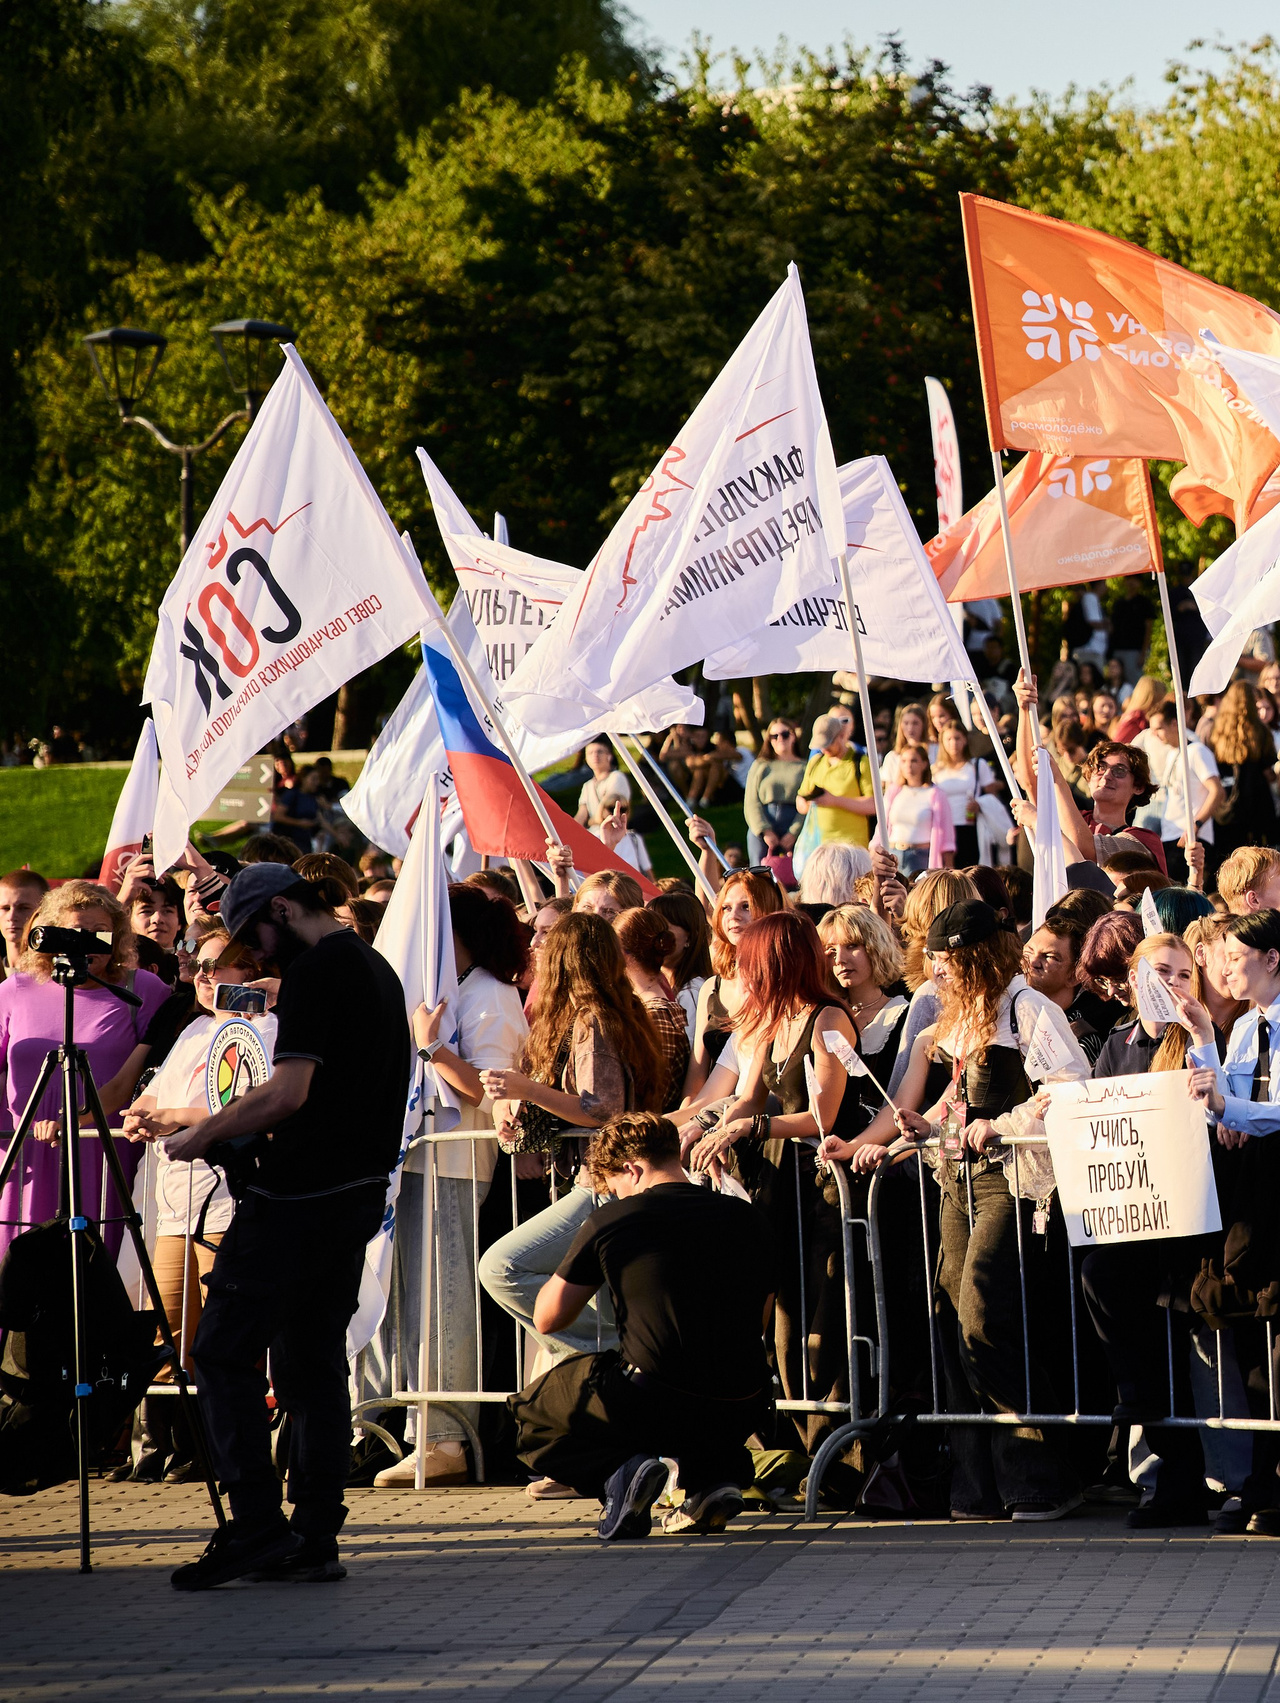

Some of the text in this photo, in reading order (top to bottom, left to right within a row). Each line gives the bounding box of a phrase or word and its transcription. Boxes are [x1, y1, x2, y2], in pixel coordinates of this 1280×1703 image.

[1089, 1116, 1144, 1151] УЧИСЬ,
[1087, 1151, 1155, 1194] ПРОБУЙ,
[1082, 1193, 1170, 1238] ОТКРЫВАЙ!
